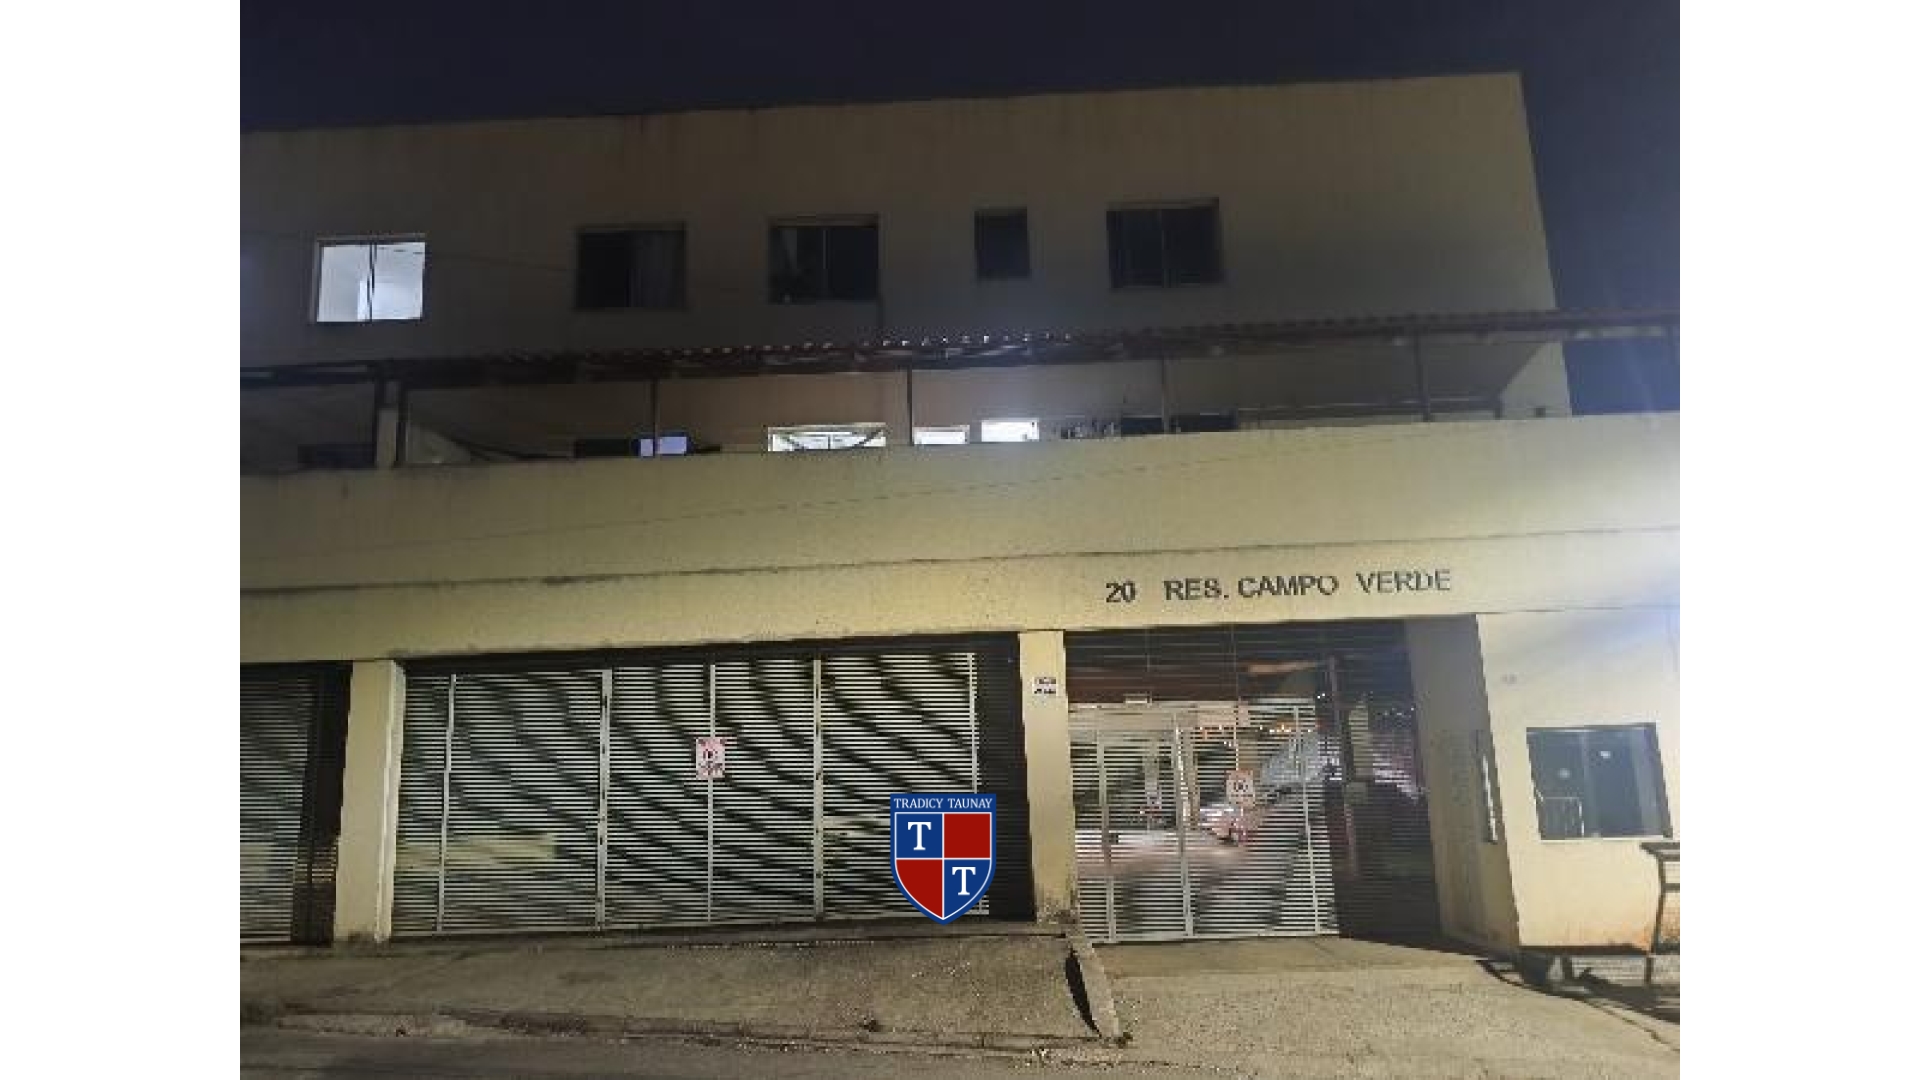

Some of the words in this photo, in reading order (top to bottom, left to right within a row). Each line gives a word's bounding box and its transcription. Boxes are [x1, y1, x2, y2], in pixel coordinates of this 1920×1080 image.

[1106, 579, 1137, 603] 20
[1164, 577, 1230, 601] RES.
[1238, 574, 1340, 599] CAMPO
[1355, 568, 1451, 594] VERDE
